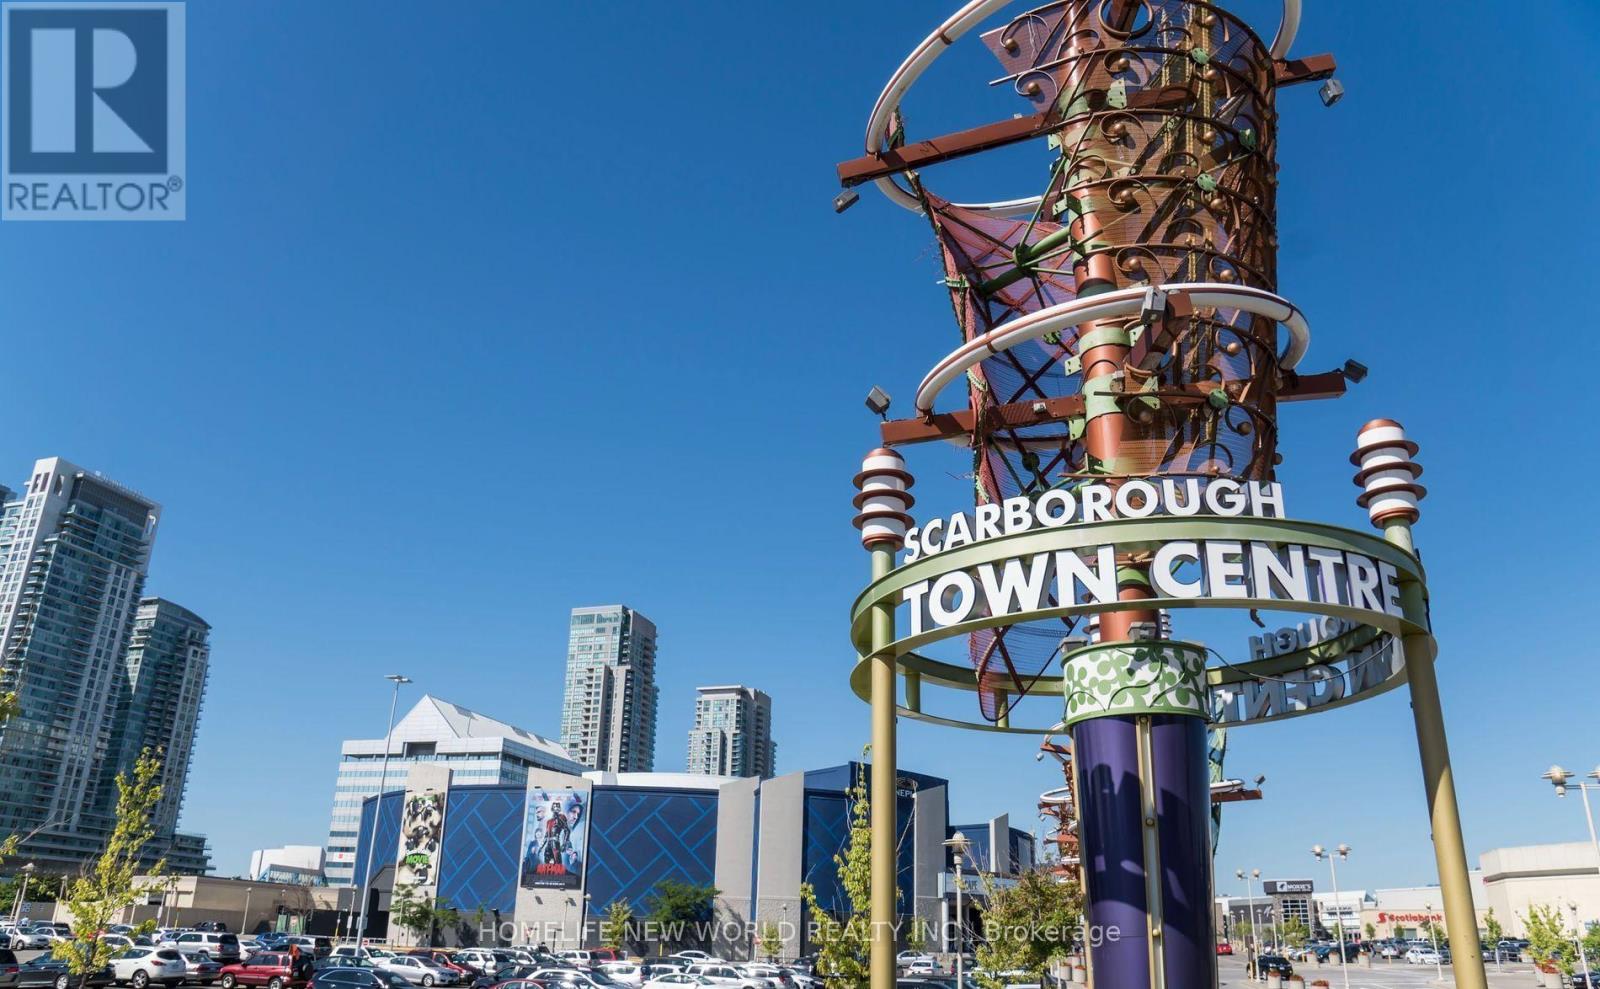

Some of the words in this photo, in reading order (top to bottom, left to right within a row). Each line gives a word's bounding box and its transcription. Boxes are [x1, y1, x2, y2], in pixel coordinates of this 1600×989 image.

[903, 478, 1285, 564] SCARBOROUGH
[903, 545, 1120, 637] TOWN
[1150, 540, 1405, 618] CENTRE
[406, 854, 429, 865] MOVIE
[1388, 913, 1443, 922] Scotiabank
